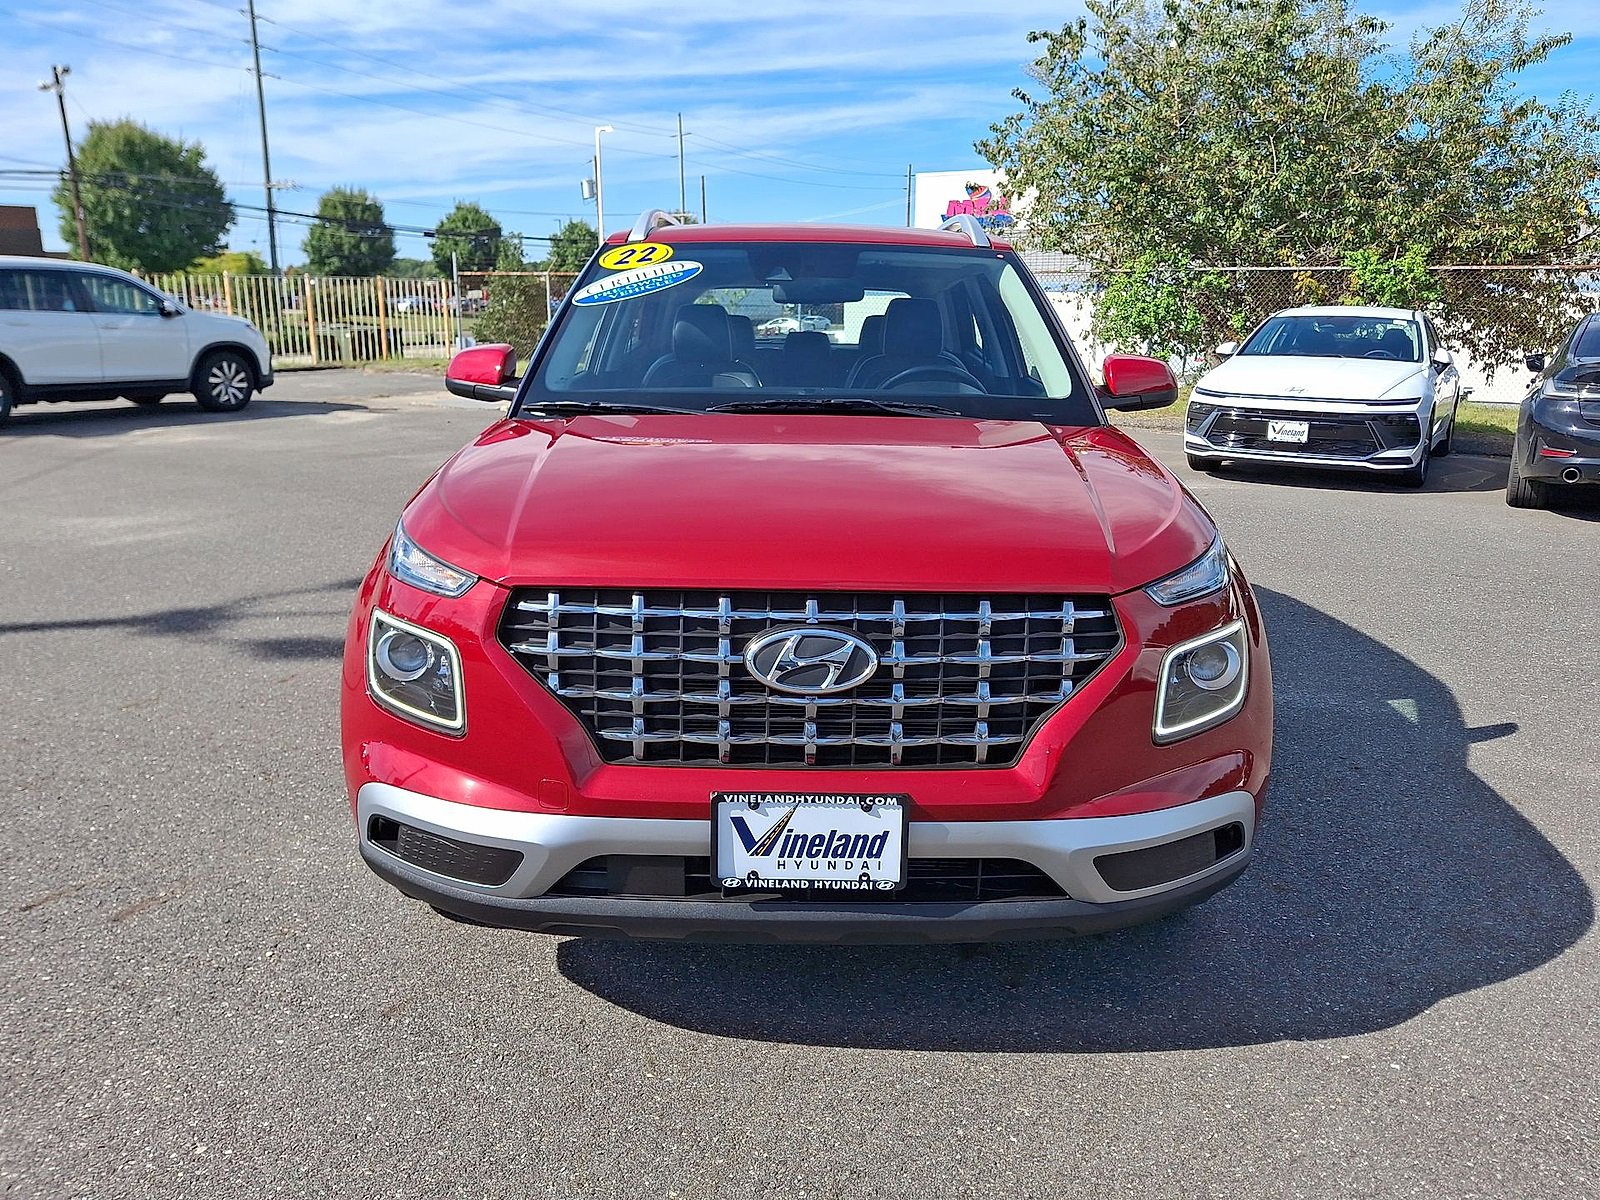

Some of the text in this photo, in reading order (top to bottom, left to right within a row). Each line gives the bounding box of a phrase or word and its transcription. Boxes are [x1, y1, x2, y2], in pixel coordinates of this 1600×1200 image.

[613, 247, 657, 265] 22
[586, 263, 685, 294] CERTIFIED
[609, 278, 673, 299] VEHICLE
[1271, 424, 1305, 437] Vineland
[723, 794, 898, 806] VINELANDHYUNDAI.COM
[729, 803, 891, 859] Vineland
[777, 860, 882, 871] HYUNDAI
[744, 879, 874, 891] VINELAND HYUNDAI
